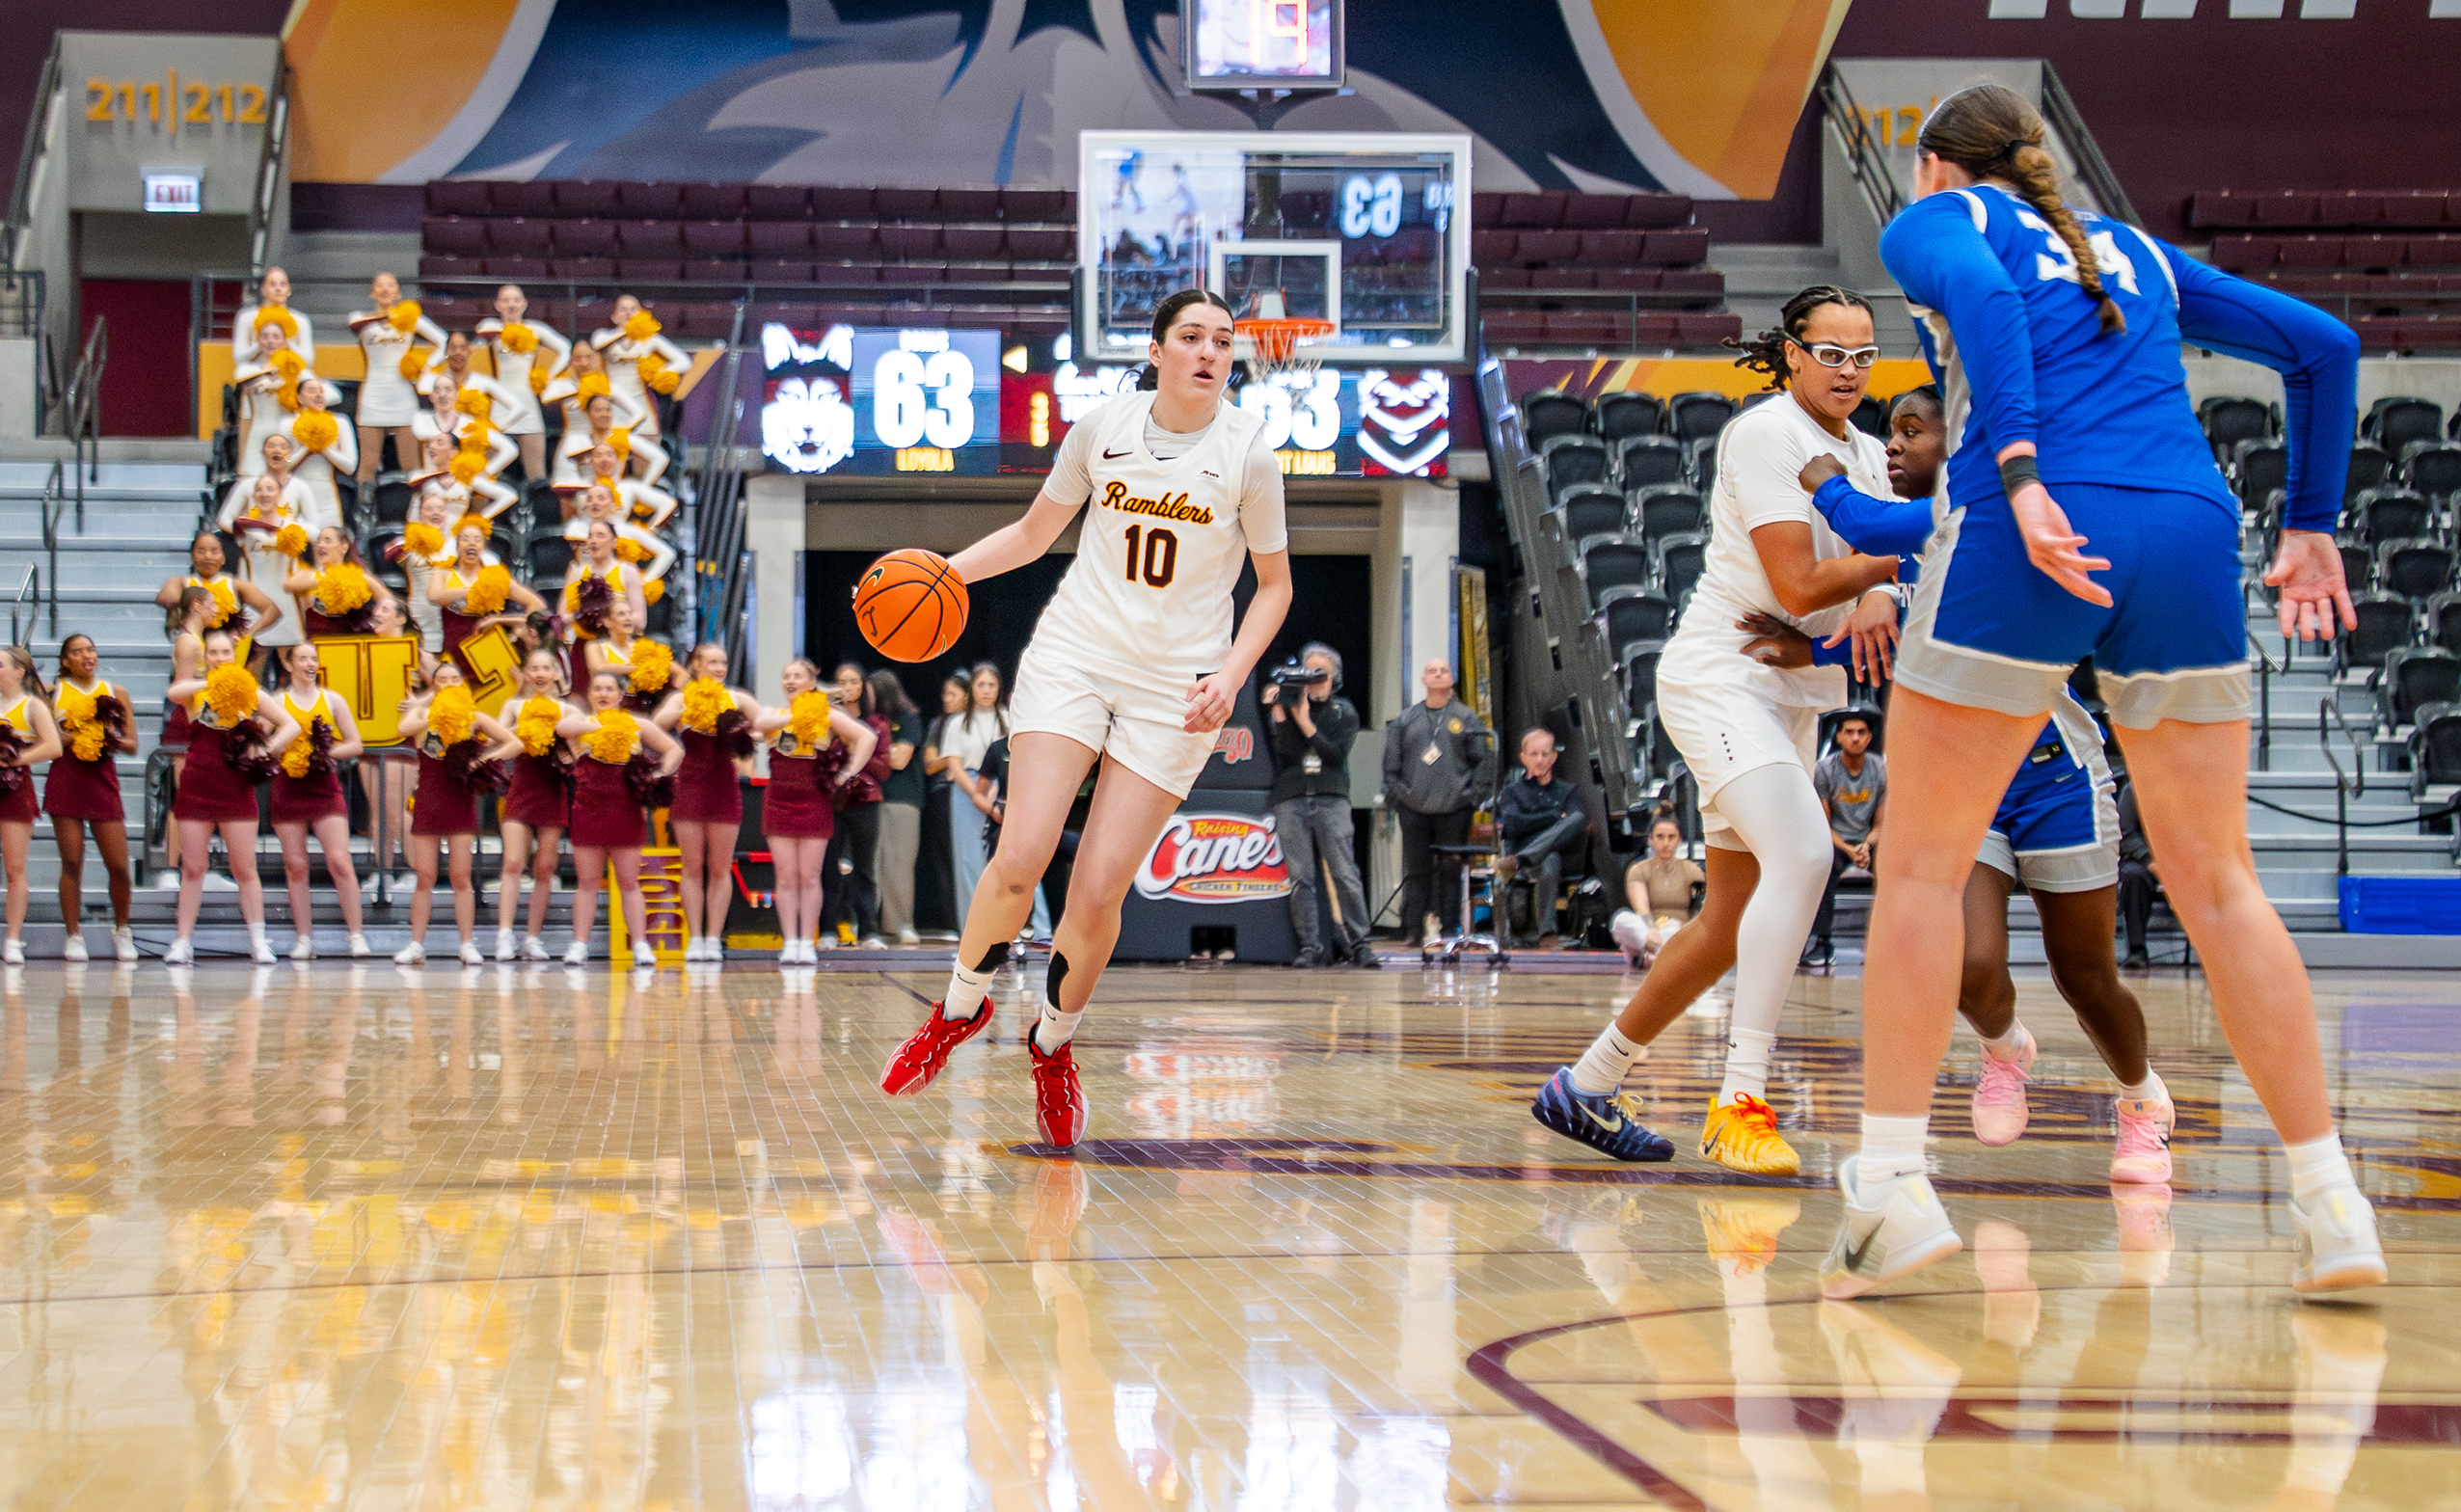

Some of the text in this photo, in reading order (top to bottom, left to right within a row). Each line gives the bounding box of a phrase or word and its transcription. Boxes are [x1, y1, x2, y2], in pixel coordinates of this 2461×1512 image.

[154, 184, 193, 203] EXIT
[2016, 209, 2142, 295] 34
[875, 349, 974, 448] 63
[896, 446, 955, 472] LOYOLA
[1101, 481, 1214, 525] Ramblers
[1124, 524, 1178, 588] 10
[1135, 815, 1285, 893] Cane's
[1193, 820, 1250, 839] Raising
